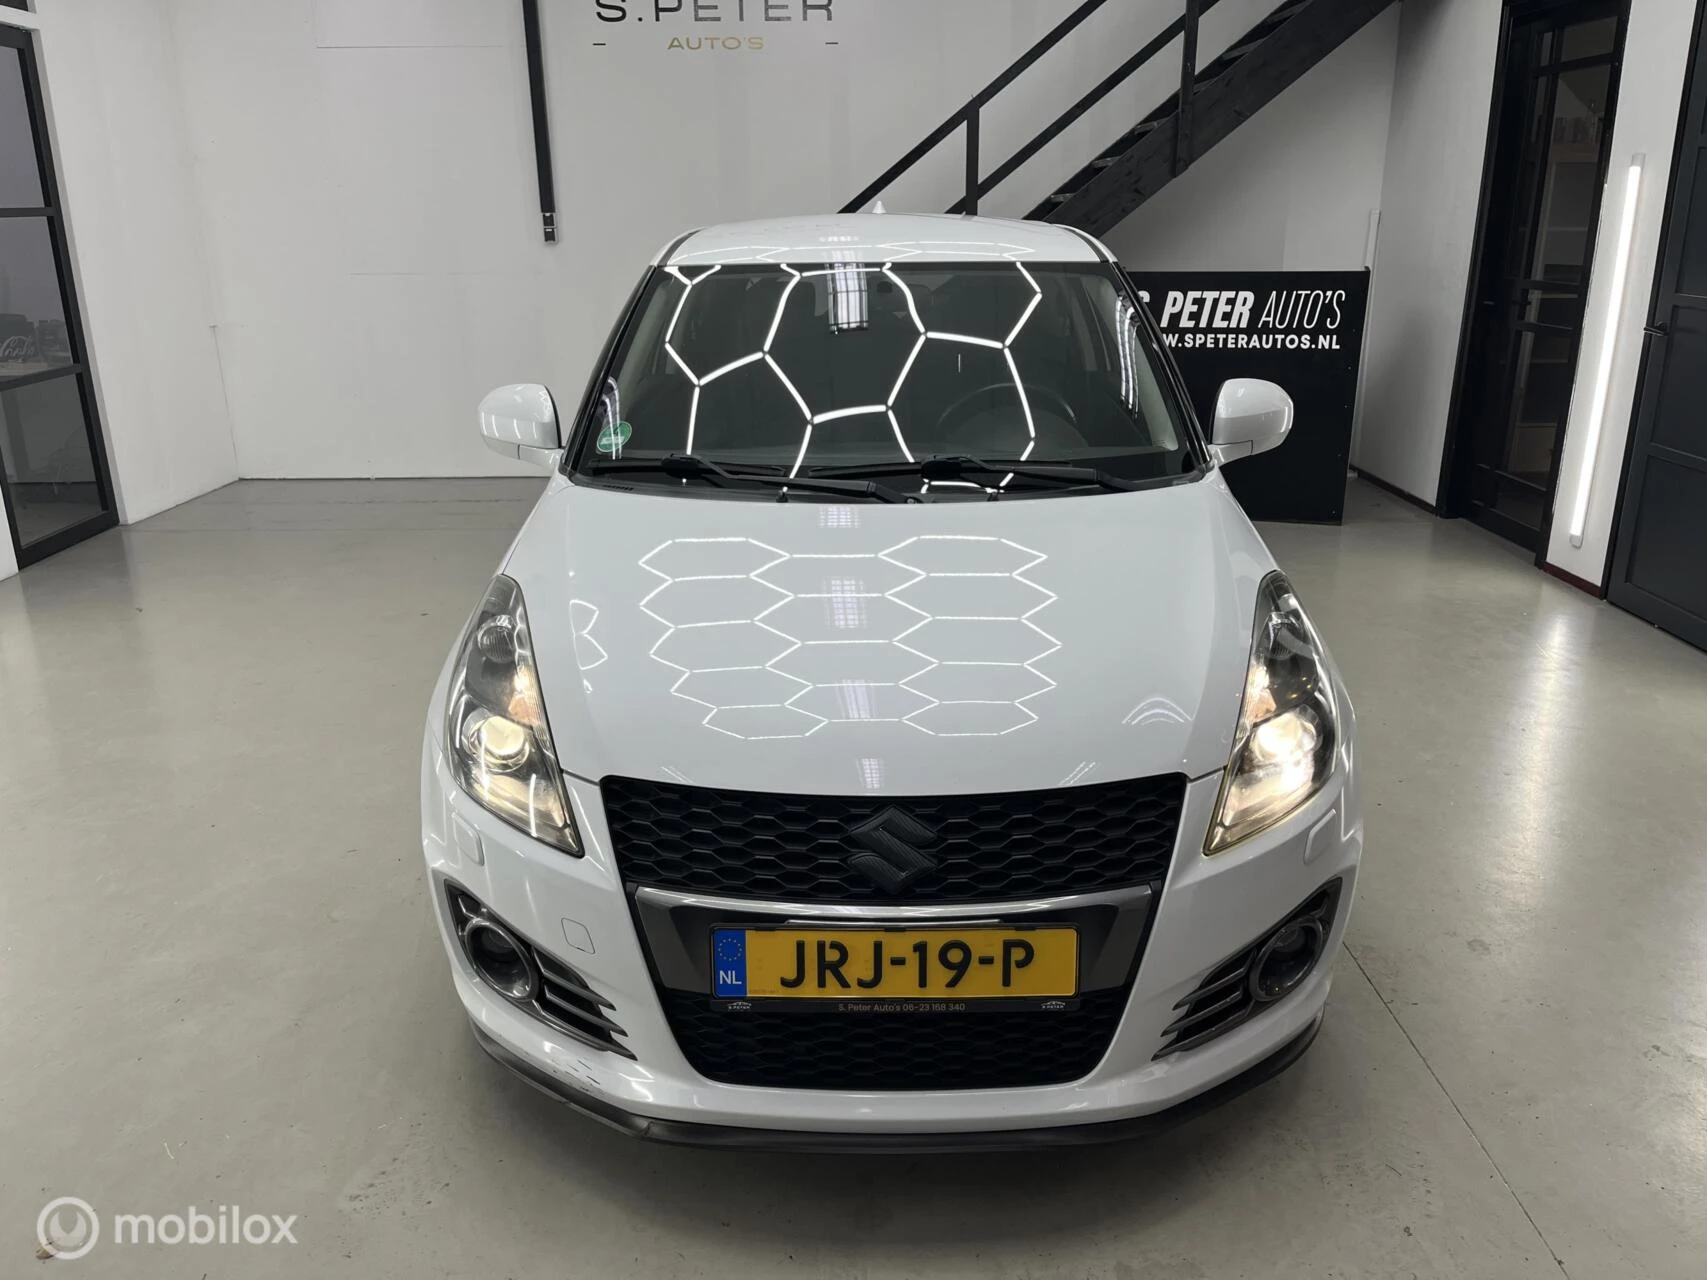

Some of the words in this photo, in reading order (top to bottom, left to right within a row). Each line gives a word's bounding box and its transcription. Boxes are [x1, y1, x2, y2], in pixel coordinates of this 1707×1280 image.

[667, 36, 765, 51] AUTO'S
[1160, 290, 1255, 328] PETER
[1258, 290, 1346, 329] AUTO'S
[780, 939, 1035, 989] JRJ-19-P
[719, 970, 742, 986] NL
[848, 1003, 871, 1012] Peter
